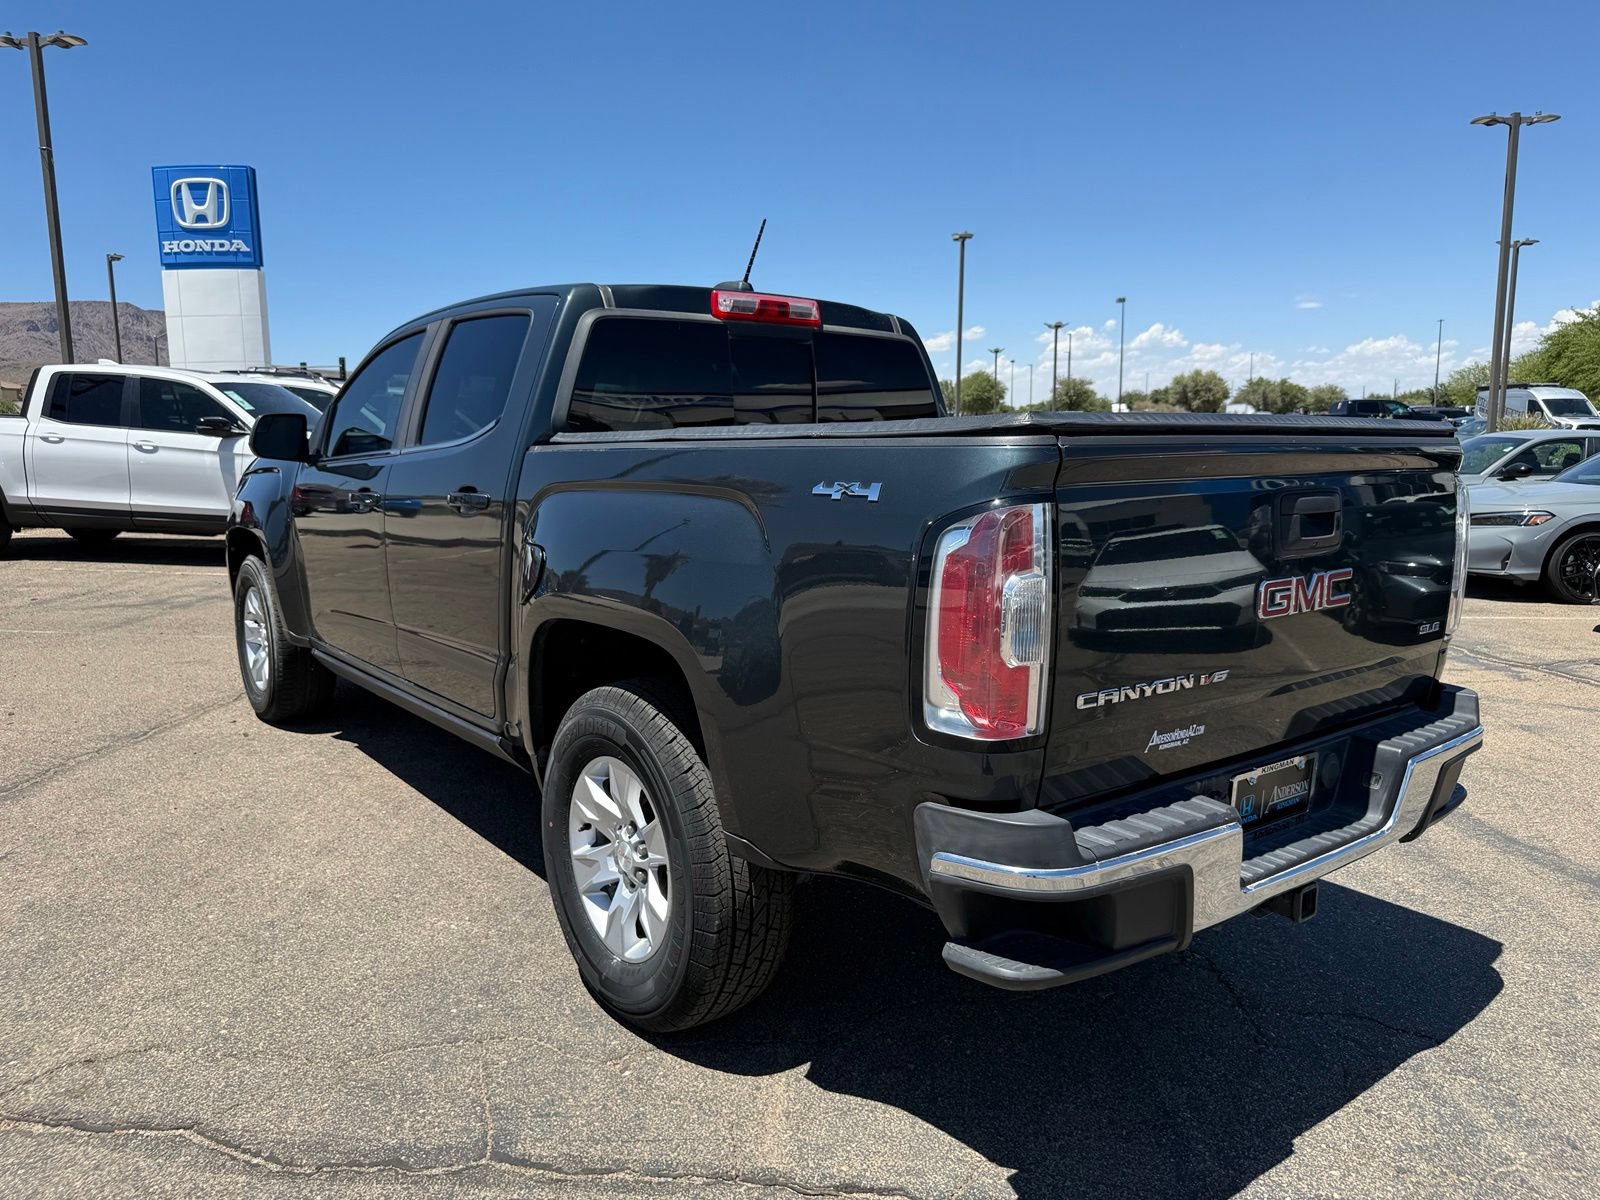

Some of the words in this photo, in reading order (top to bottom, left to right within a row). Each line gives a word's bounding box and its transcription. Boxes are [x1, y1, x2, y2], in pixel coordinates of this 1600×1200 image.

[162, 239, 251, 253] HONDA
[1257, 567, 1354, 619] GMC
[1075, 673, 1195, 710] CANYON
[1199, 669, 1230, 687] V6
[1261, 758, 1295, 774] KINGMAN
[1264, 779, 1309, 814] ANDERSON
